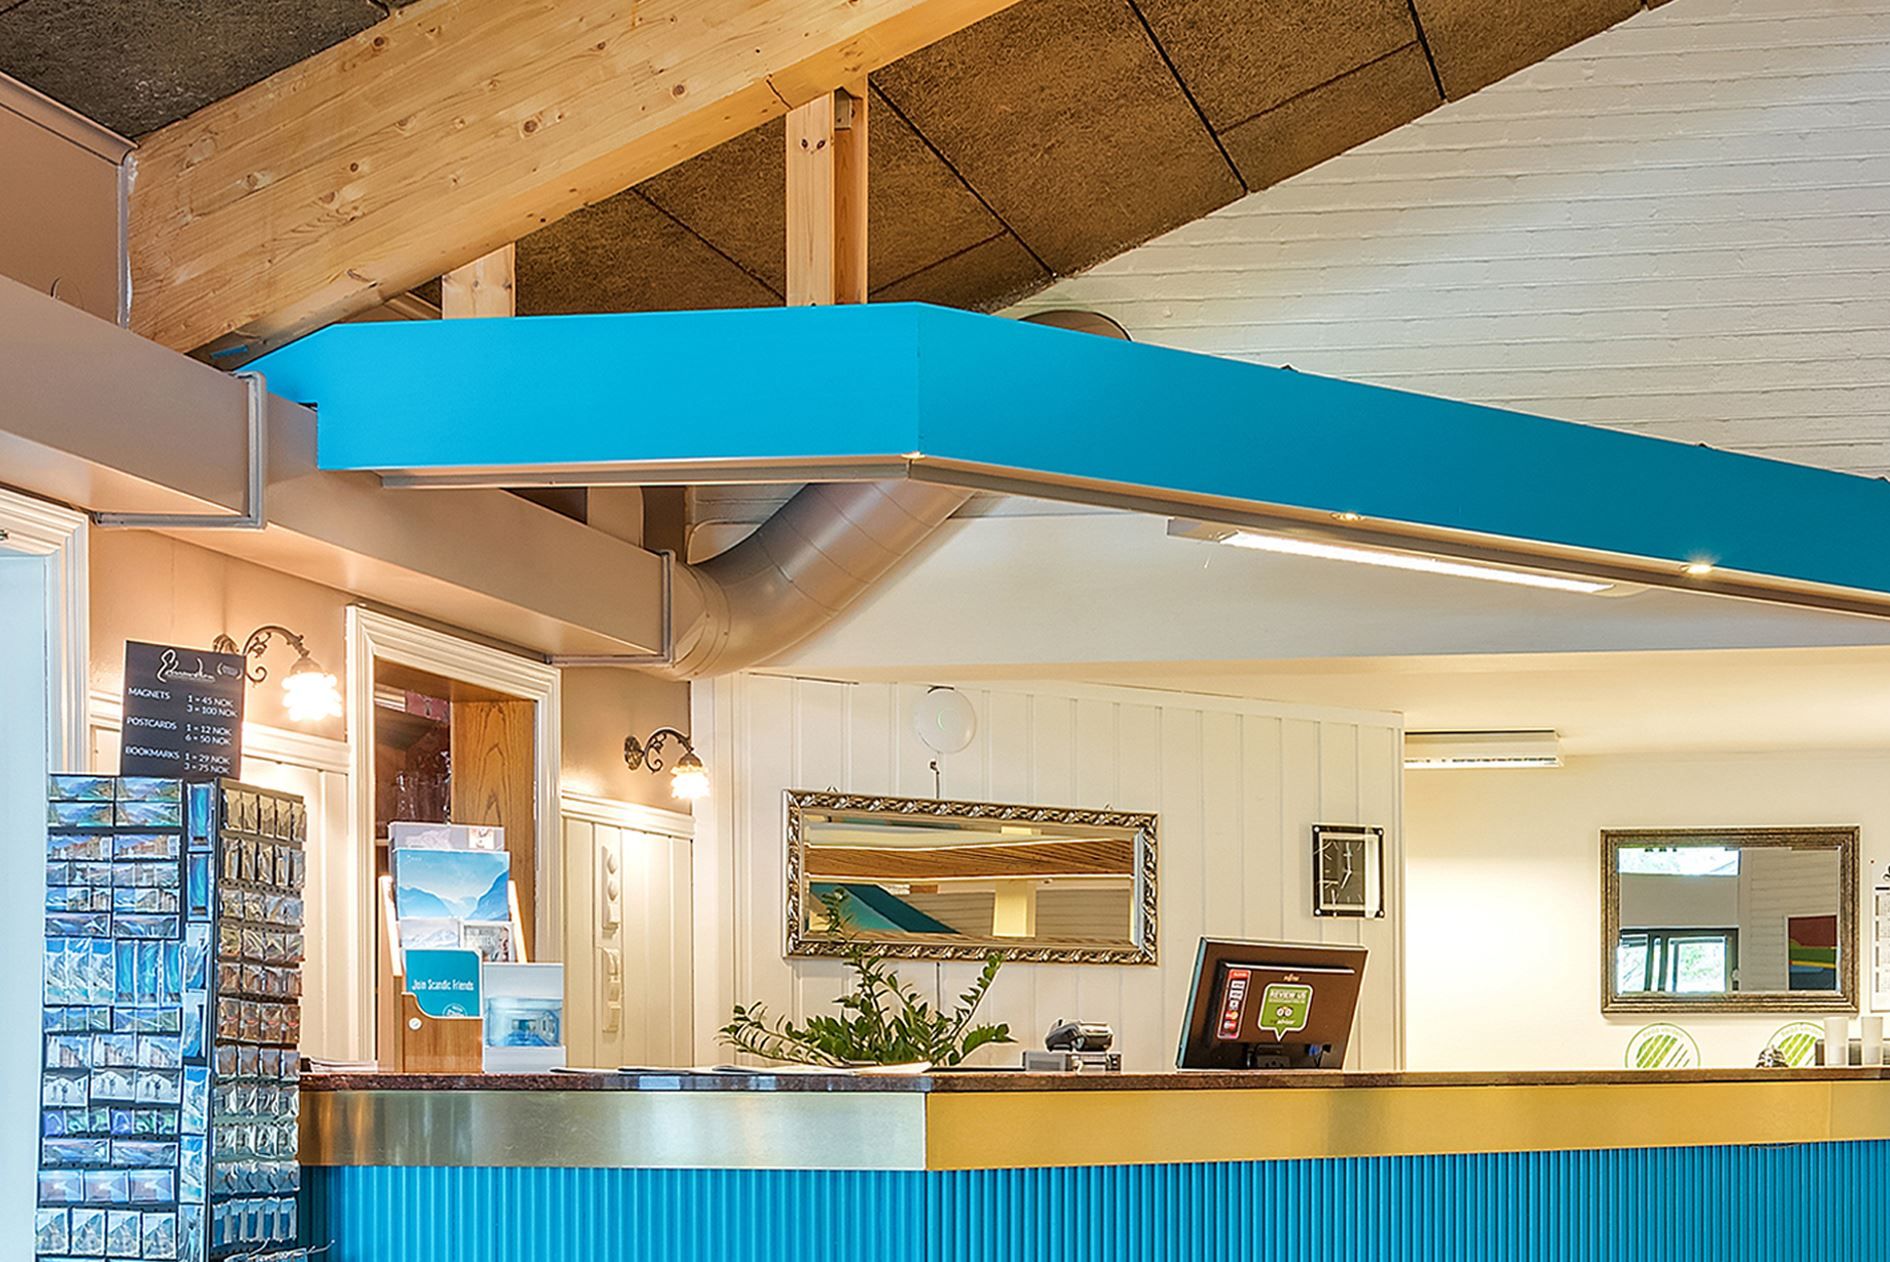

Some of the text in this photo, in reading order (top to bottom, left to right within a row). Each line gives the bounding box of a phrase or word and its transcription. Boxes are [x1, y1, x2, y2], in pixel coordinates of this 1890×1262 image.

[127, 687, 171, 700] MAGNETS
[213, 698, 234, 708] NOK
[186, 704, 193, 713] 3
[201, 706, 217, 715] 100
[218, 708, 238, 718] NOK
[126, 716, 177, 731] POSTCARDS
[186, 723, 192, 732] 1
[200, 725, 211, 734] 12
[212, 727, 232, 737] NOK
[184, 734, 192, 742] 6
[212, 736, 232, 746] NOK
[125, 745, 180, 760] BOOKMARKS
[184, 752, 190, 761] 1
[210, 755, 231, 765] NOK
[210, 765, 230, 774] NOK
[411, 978, 475, 991] Join Scandic Friends
[1269, 989, 1307, 1000] REVIEW US
